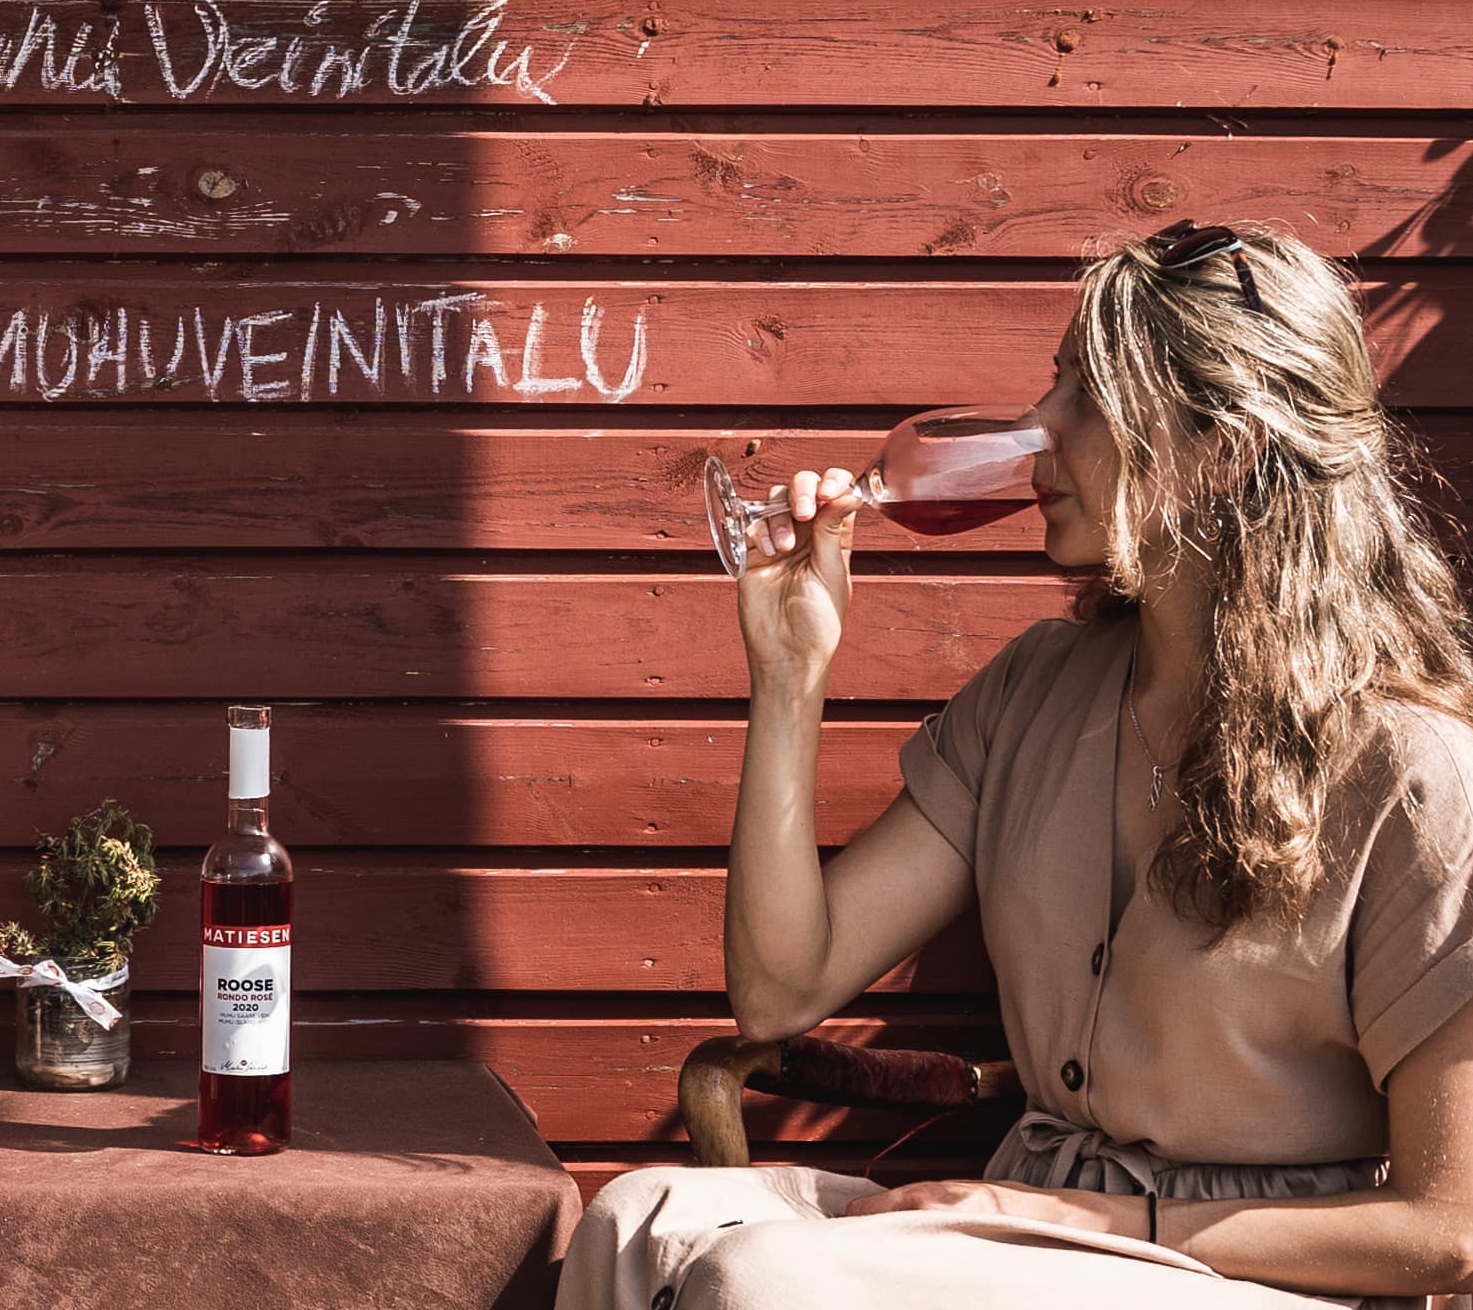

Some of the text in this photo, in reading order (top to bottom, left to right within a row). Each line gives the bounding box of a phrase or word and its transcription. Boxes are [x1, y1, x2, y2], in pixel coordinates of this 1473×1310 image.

[203, 927, 290, 944] MATIESEN
[217, 978, 273, 992] ROOSE
[217, 993, 248, 1002] RONDO
[232, 1003, 259, 1012] 2020
